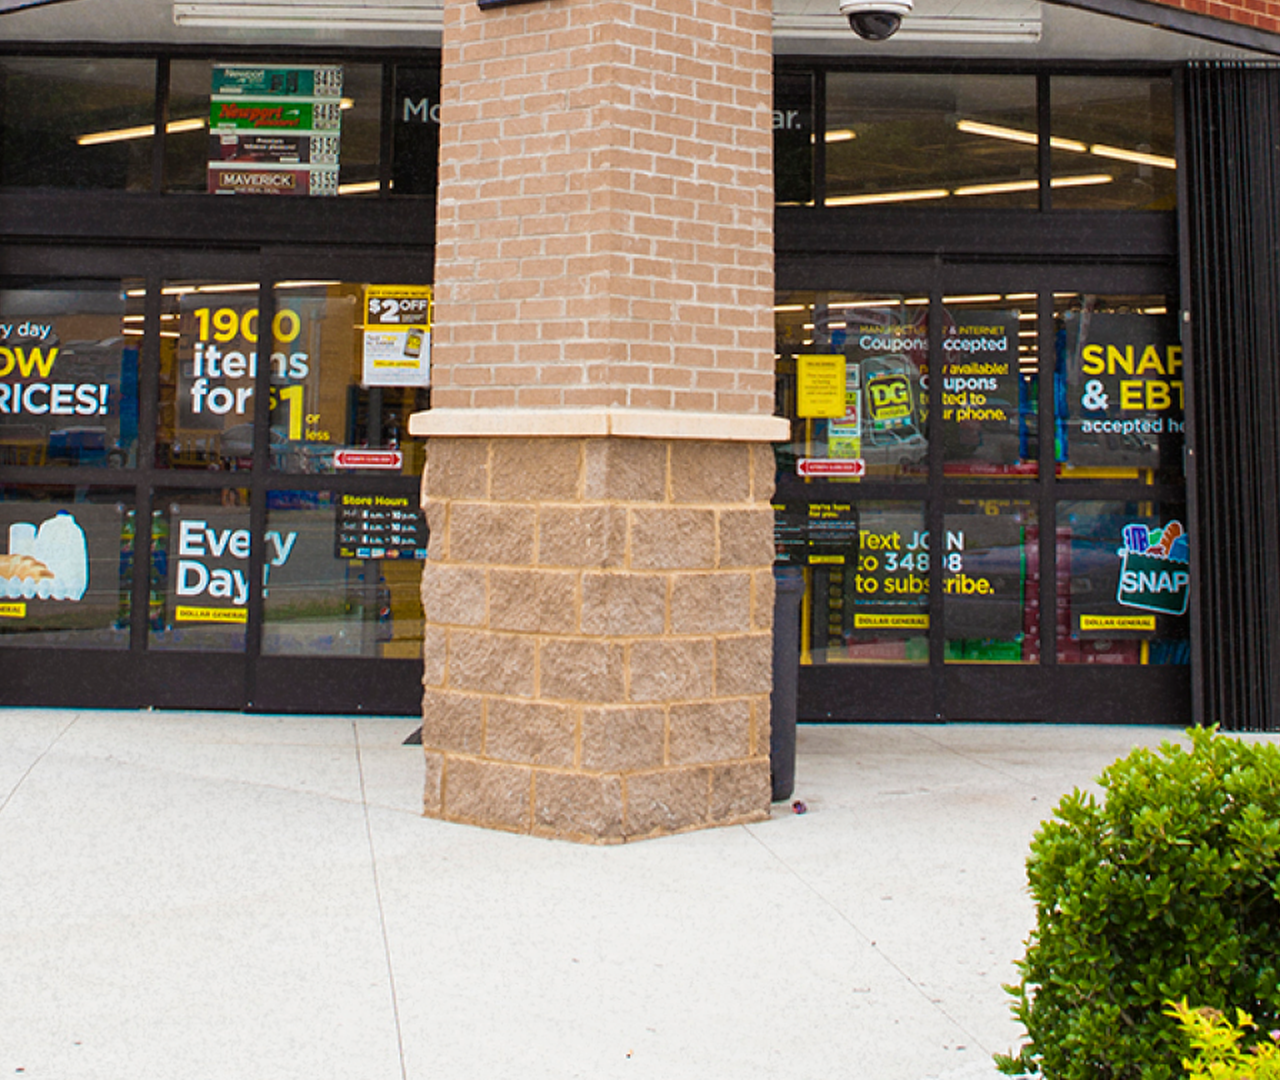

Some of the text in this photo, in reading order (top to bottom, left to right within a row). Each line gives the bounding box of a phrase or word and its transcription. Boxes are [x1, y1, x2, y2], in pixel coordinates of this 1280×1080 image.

[219, 103, 284, 123] Newport
[223, 173, 291, 187] MAVERICK
[369, 298, 400, 323] $2
[400, 300, 428, 311] OFF
[18, 321, 52, 340] day
[959, 326, 1005, 335] INTERNET
[943, 335, 1008, 353] ccepted
[1082, 344, 1183, 375] SNAP
[949, 363, 1009, 376] available!
[920, 375, 998, 393] Cupons
[190, 378, 254, 414] for
[870, 382, 908, 406] DG
[969, 393, 987, 405] to
[1081, 379, 1185, 411] & EBT
[306, 413, 321, 424] or
[955, 406, 1007, 423] phone.
[306, 430, 330, 440] less
[1081, 418, 1164, 435] accepted
[342, 495, 409, 506] Store Hours
[179, 520, 299, 566] Evey
[859, 530, 901, 551] Text
[884, 551, 963, 572] 3488
[854, 573, 995, 595] to subsribe.
[1122, 570, 1188, 594] SNAP
[179, 609, 211, 617] DOLLAR
[857, 616, 926, 625] DOLLAR GENERAL
[1083, 618, 1152, 627] DOLLAR GENERAL
